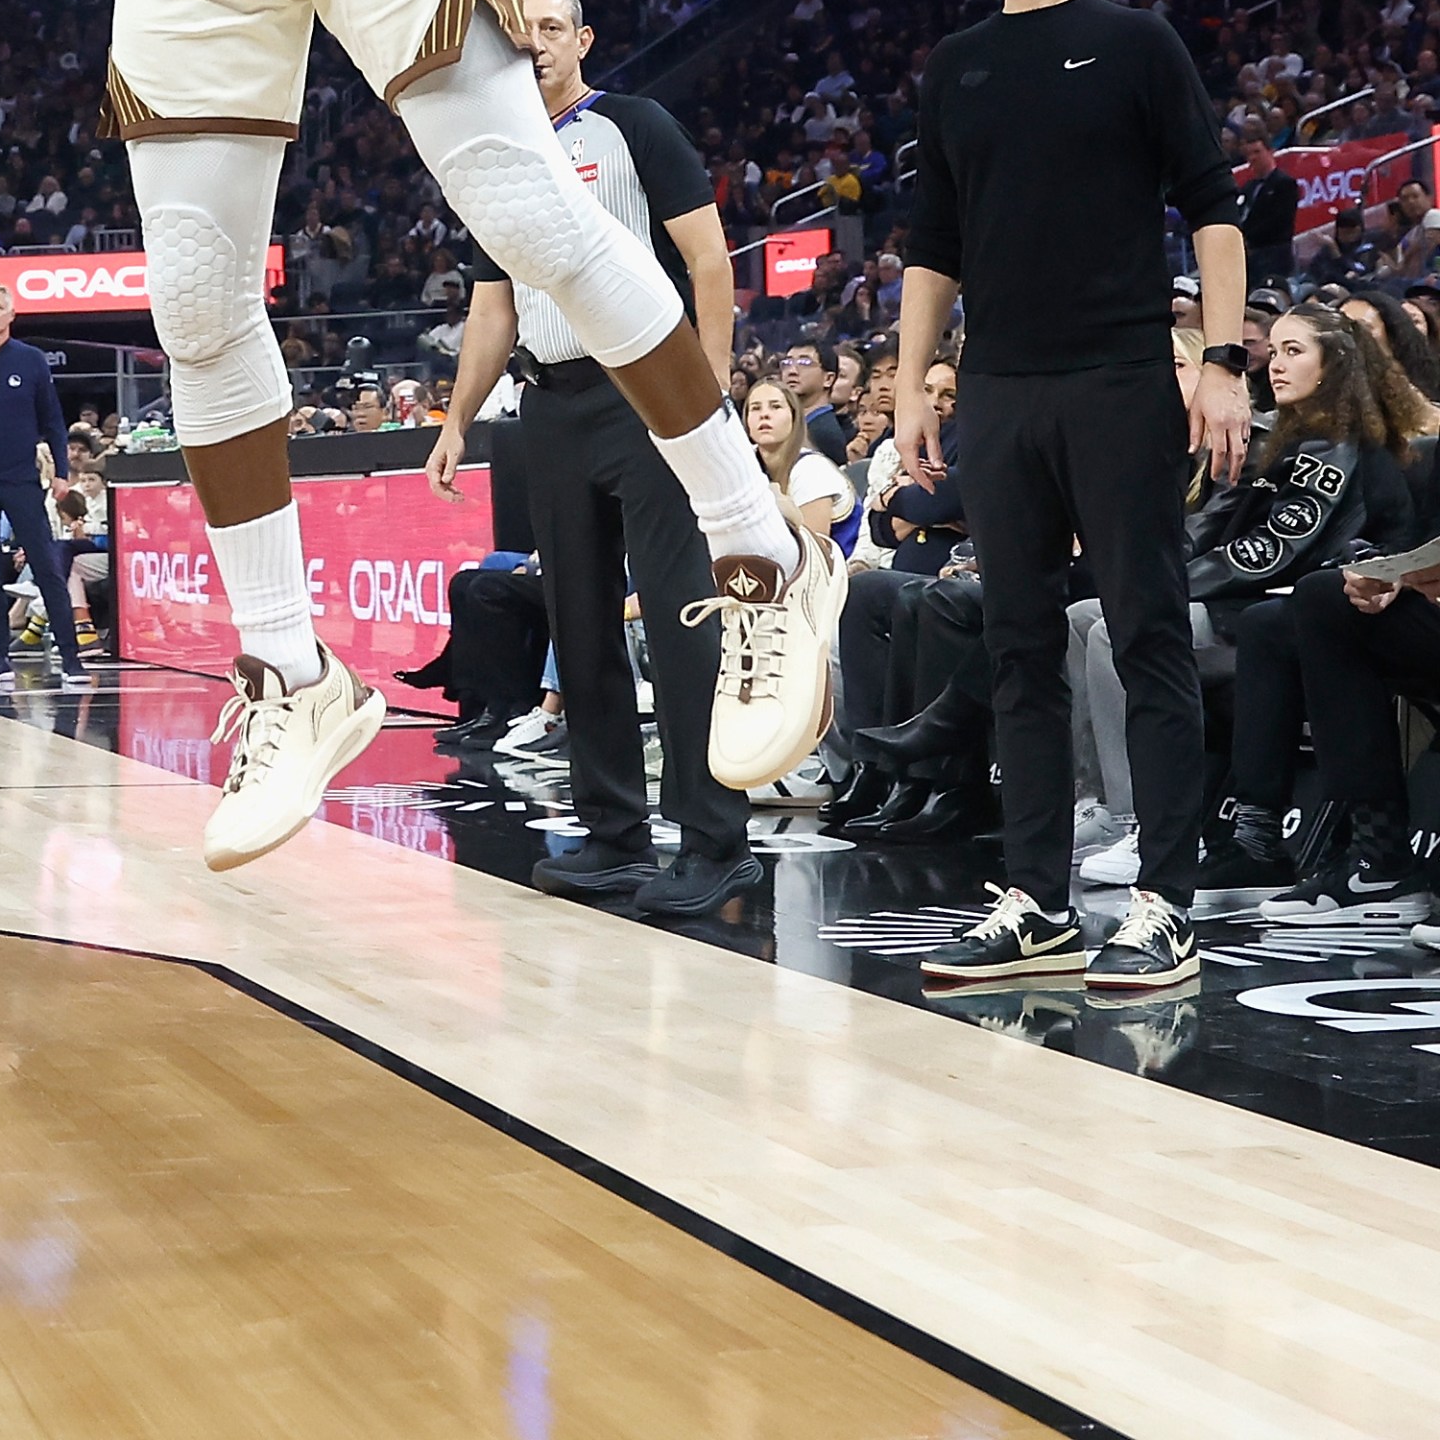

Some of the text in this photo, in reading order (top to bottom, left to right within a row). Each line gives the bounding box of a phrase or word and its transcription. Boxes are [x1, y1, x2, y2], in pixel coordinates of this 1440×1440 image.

[1289, 453, 1345, 497] 78
[129, 550, 209, 605] ORACLE
[348, 559, 478, 626] ORACL
